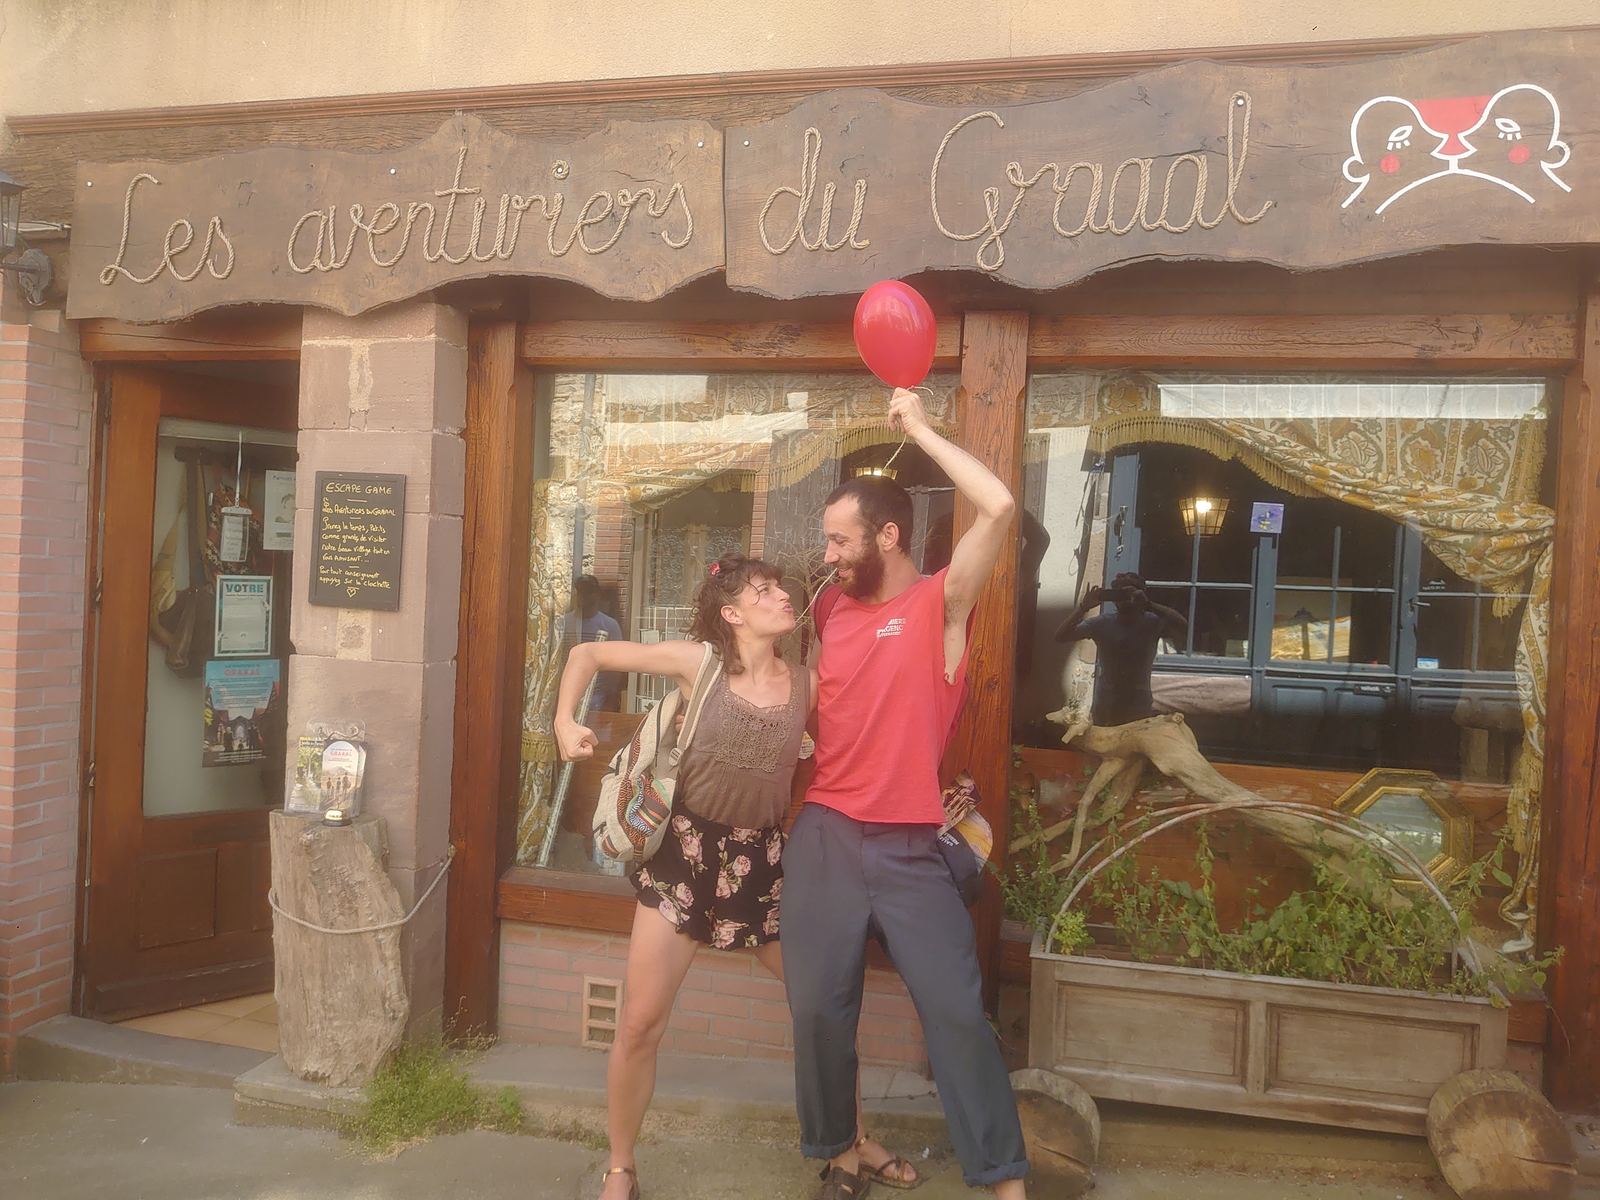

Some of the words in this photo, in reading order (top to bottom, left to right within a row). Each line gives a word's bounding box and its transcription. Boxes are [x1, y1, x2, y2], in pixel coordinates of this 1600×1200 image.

[99, 172, 236, 286] Les
[287, 146, 694, 274] aventuriers
[758, 127, 871, 257] du
[325, 482, 361, 493] ESCAPE
[365, 486, 393, 495] GAME
[225, 583, 264, 593] VOTRE
